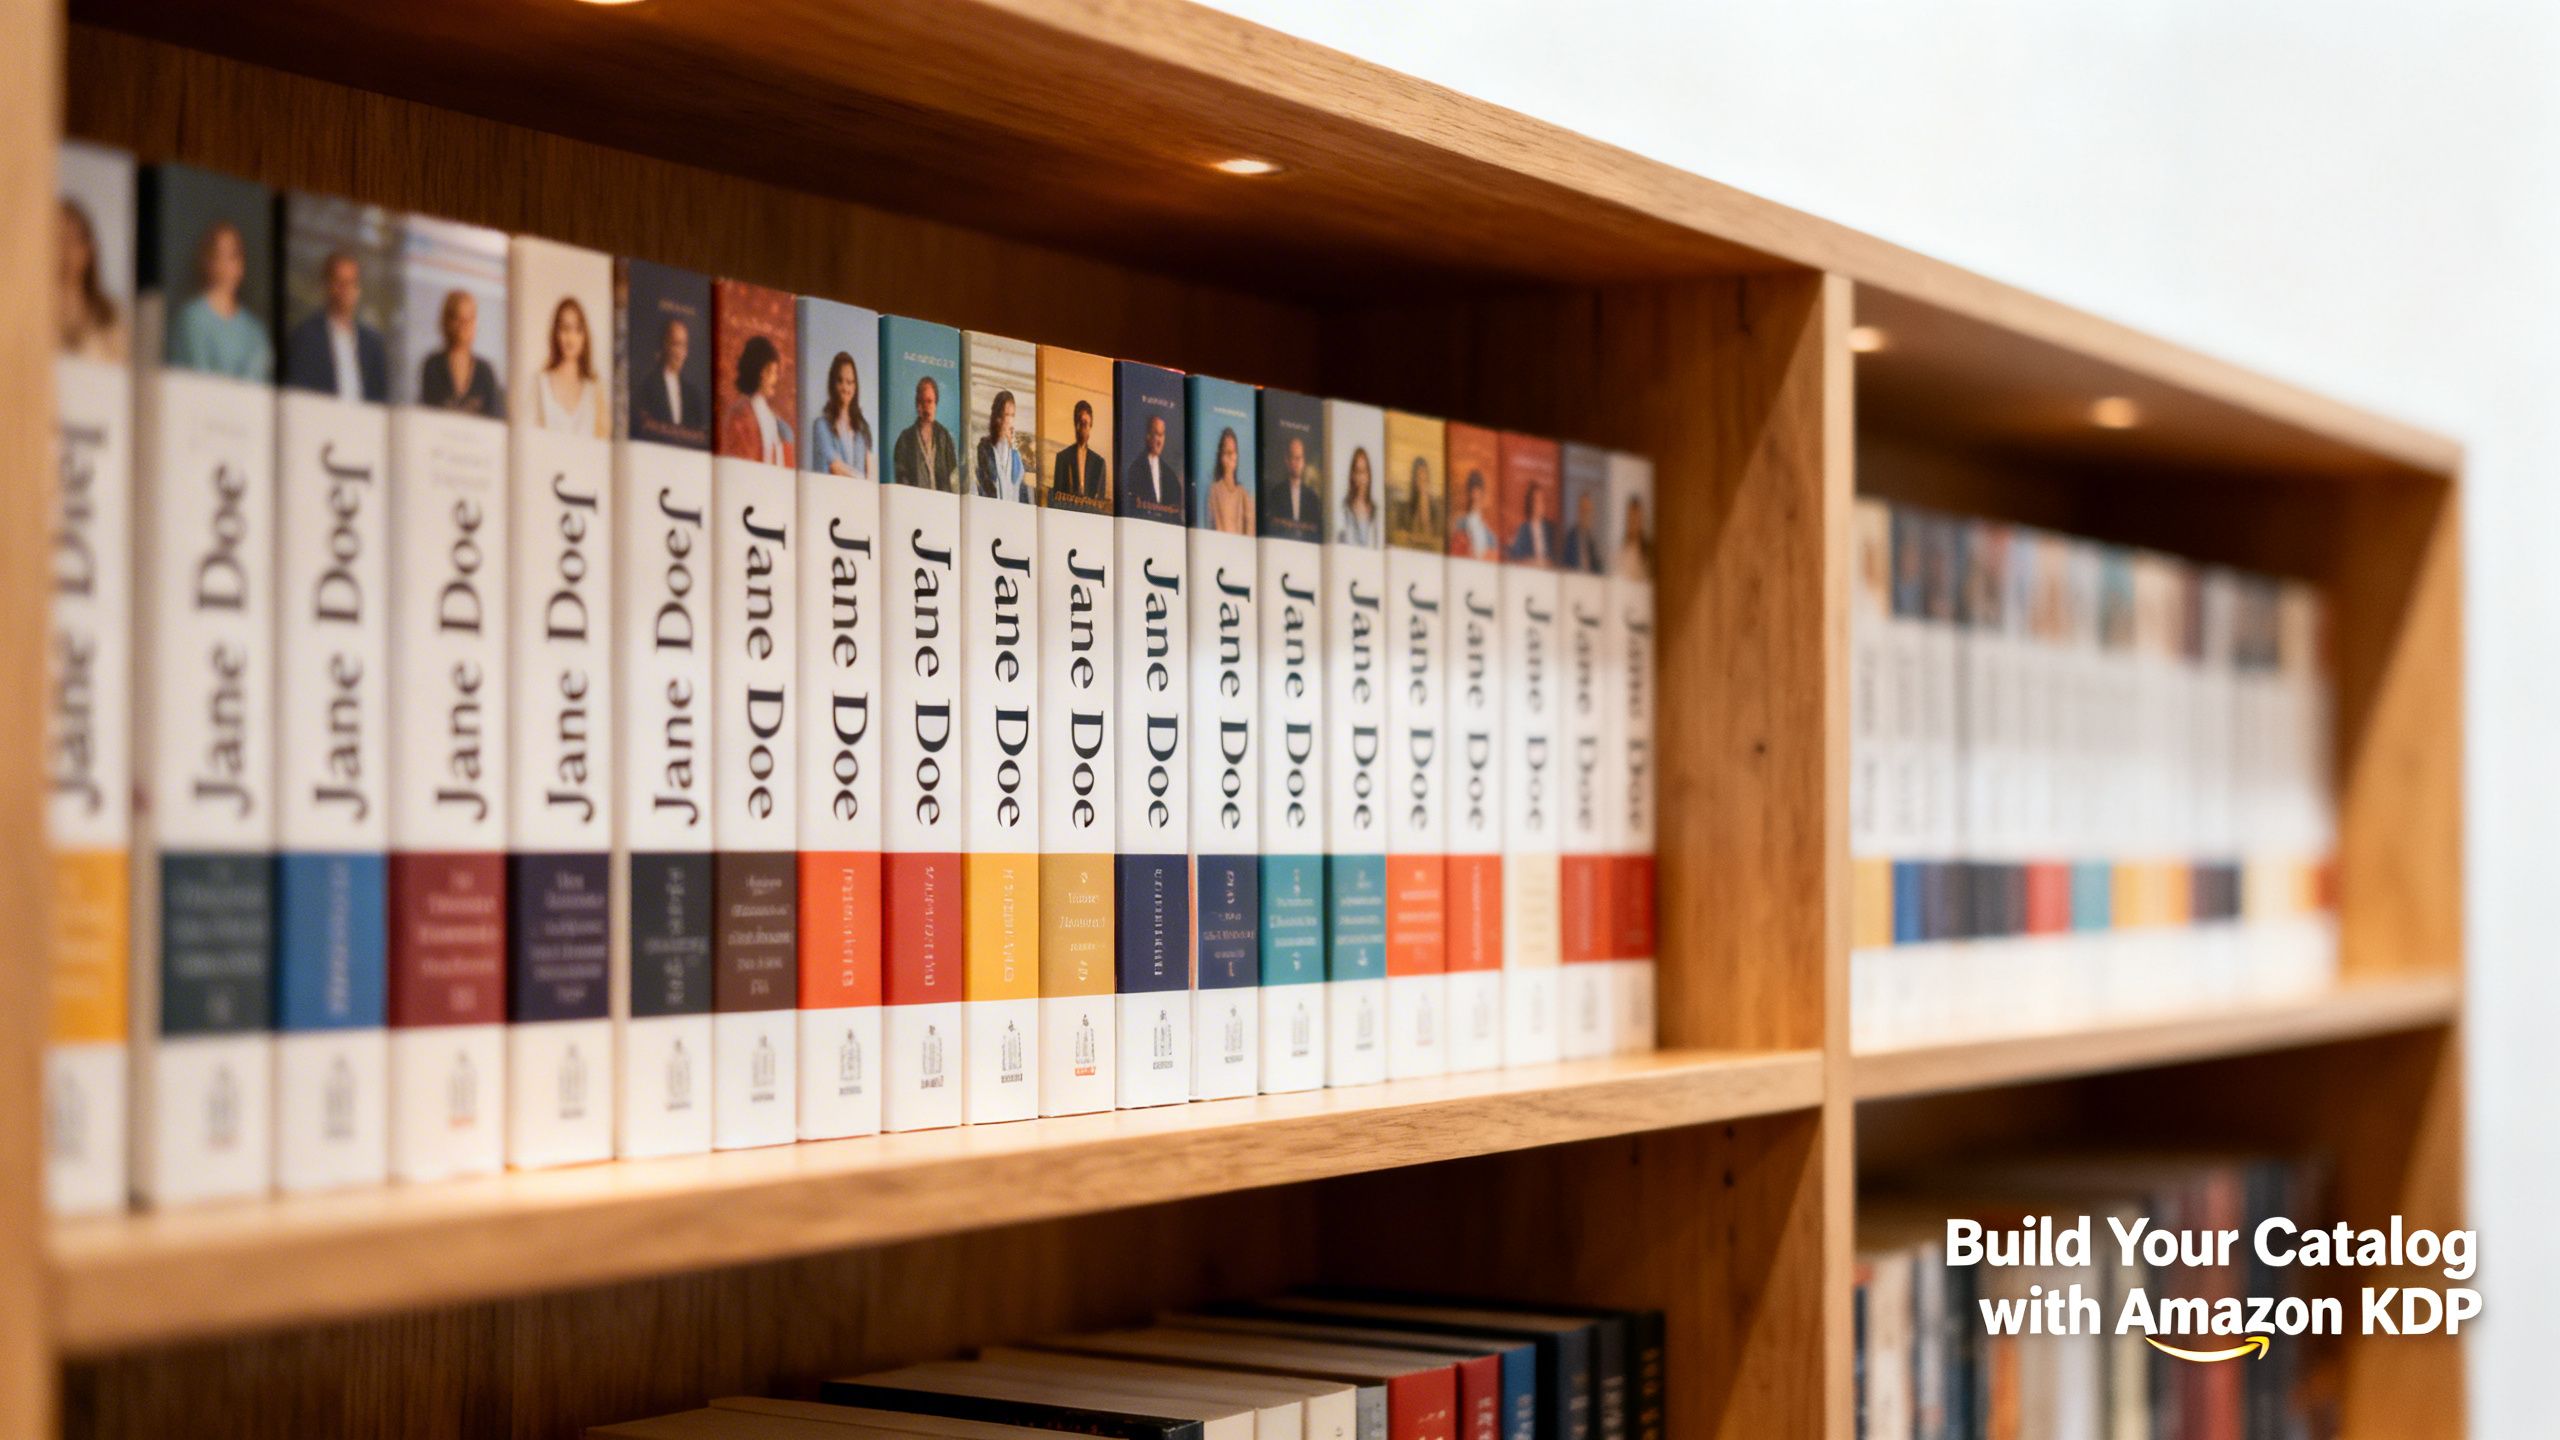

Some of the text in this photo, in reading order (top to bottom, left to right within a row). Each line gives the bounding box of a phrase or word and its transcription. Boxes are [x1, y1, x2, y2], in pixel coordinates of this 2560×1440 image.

[195, 463, 246, 611] Doe
[438, 500, 482, 635] Doe
[828, 517, 871, 668] Jane
[991, 537, 1031, 683] Jane
[742, 505, 786, 819] Jane Doe
[911, 528, 952, 826] Jane Doe
[1067, 548, 1105, 689] Jane
[1143, 557, 1180, 692] Jane
[193, 644, 254, 819] Jane
[312, 653, 369, 822] Jane
[436, 663, 488, 822] Jane
[546, 671, 595, 824] Jane
[653, 679, 699, 827] Jane
[832, 694, 868, 821] Doe
[995, 707, 1029, 828] Doe
[1071, 710, 1104, 828] Doe
[1146, 713, 1179, 828] Doe
[1215, 567, 1251, 830] Jane Doe
[1280, 572, 1315, 827] Jane Doe
[1349, 580, 1380, 828] Jane Doe
[1407, 582, 1439, 828] Jane Doe
[1465, 591, 1495, 827] Jane Doe
